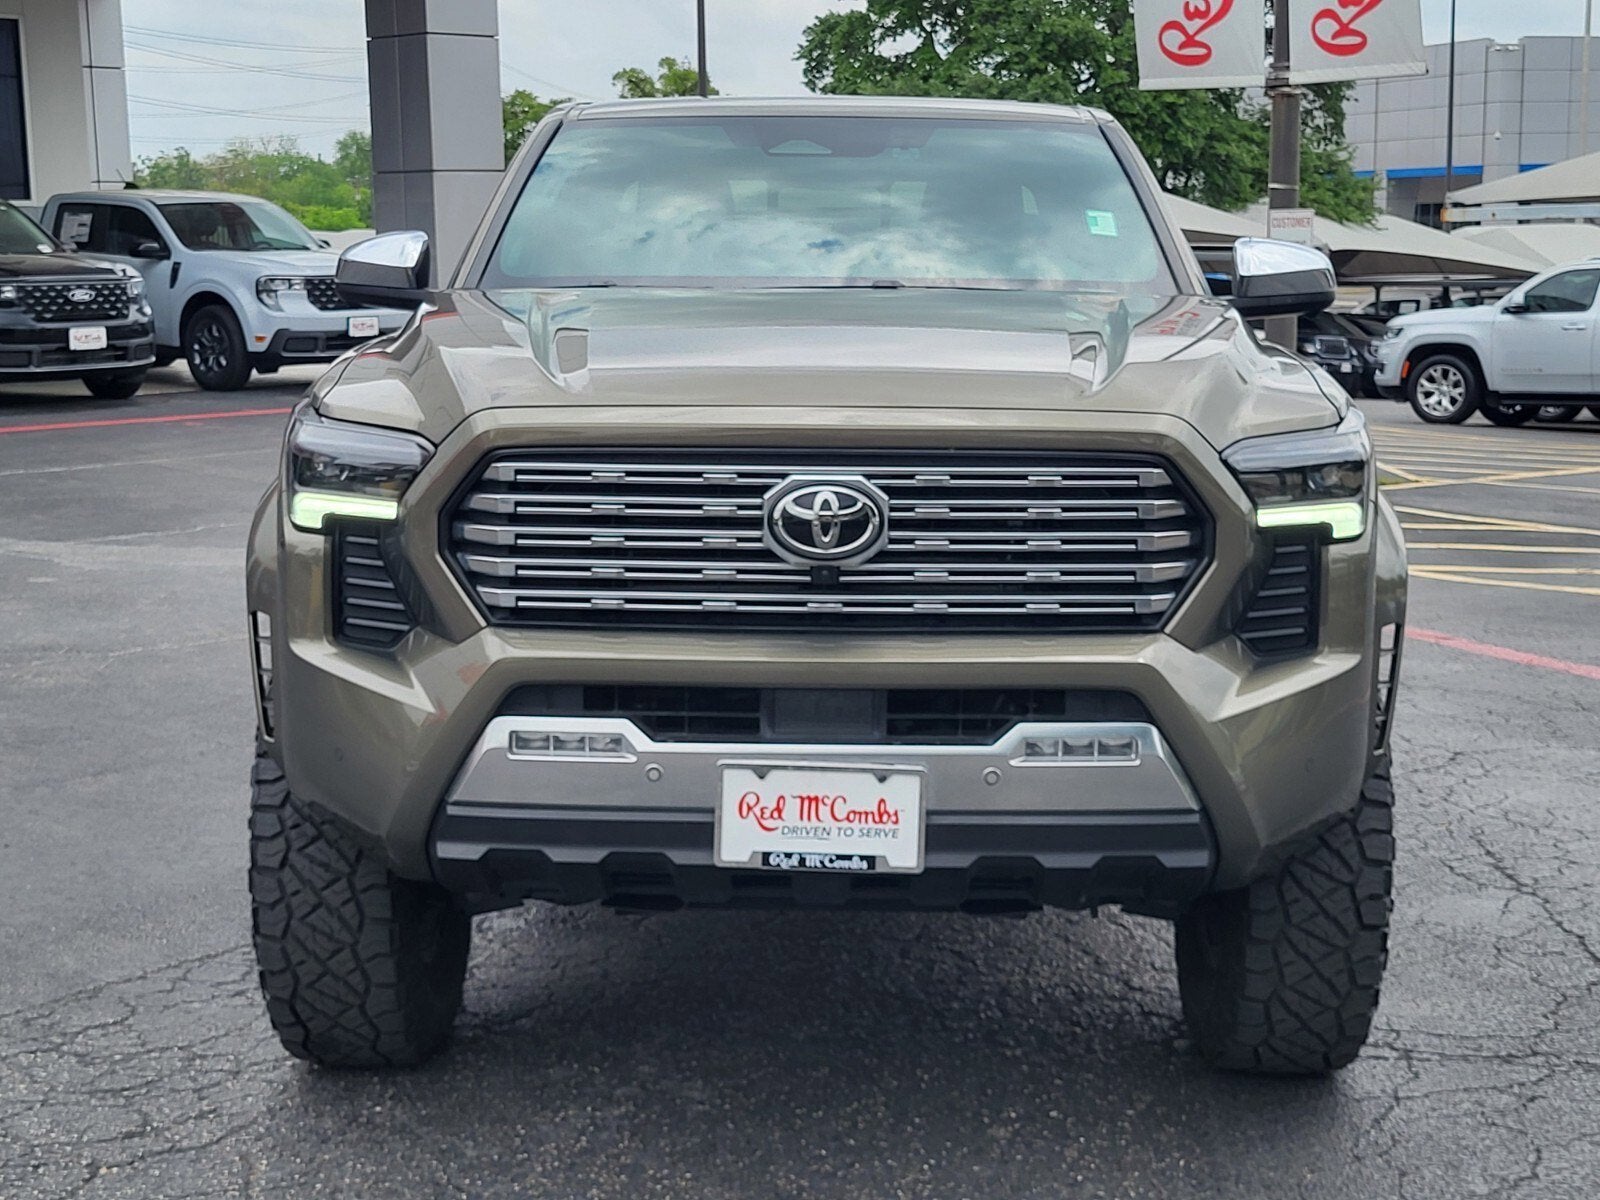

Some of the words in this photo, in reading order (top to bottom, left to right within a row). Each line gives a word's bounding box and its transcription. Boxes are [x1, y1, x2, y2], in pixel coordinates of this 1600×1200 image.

[738, 791, 786, 831] Red
[791, 795, 899, 825] McCombs
[781, 825, 831, 836] DRIVEN
[837, 827, 854, 837] TO
[858, 828, 899, 839] SERVE
[768, 852, 799, 869] Red
